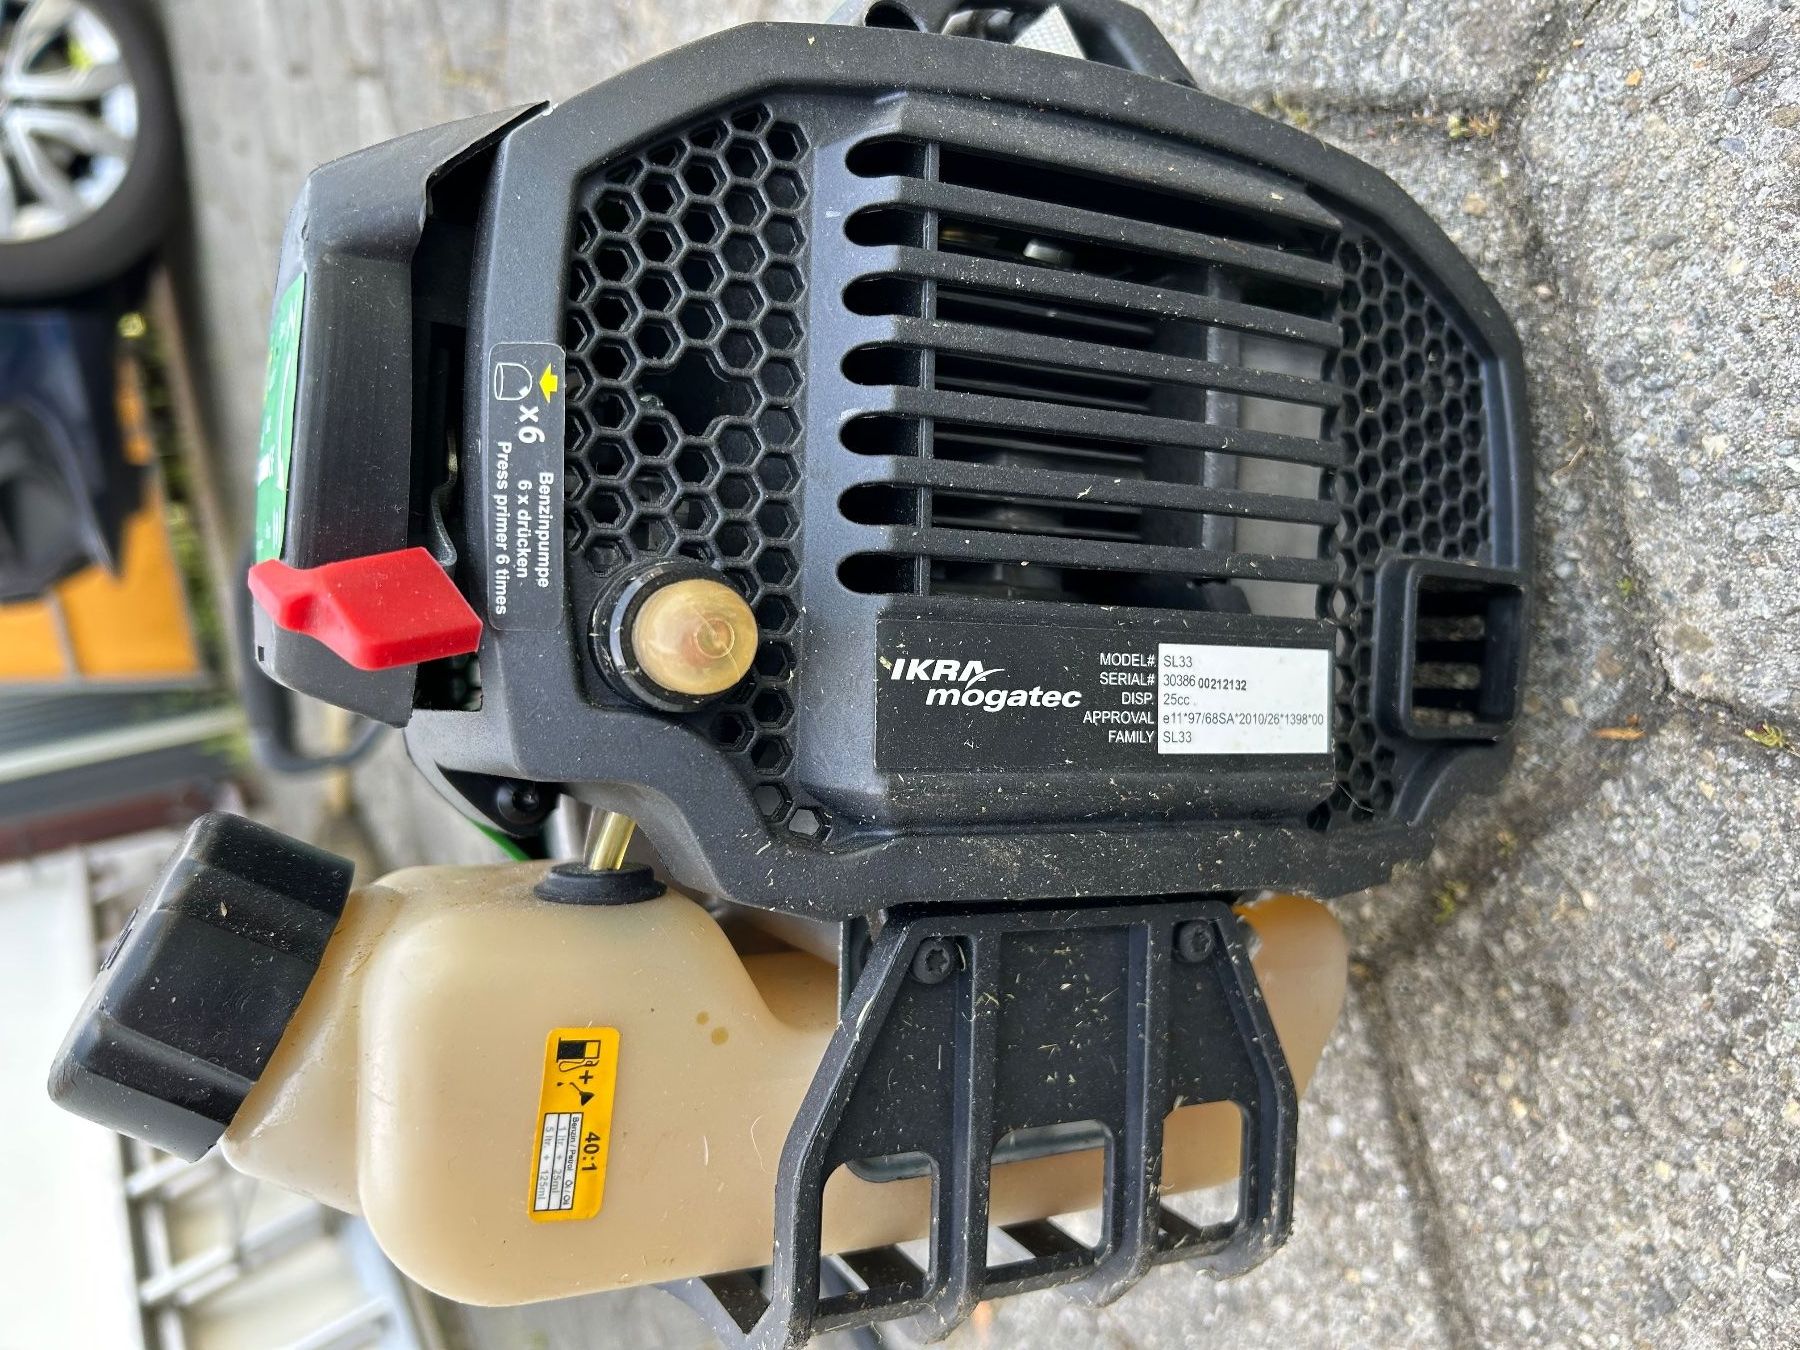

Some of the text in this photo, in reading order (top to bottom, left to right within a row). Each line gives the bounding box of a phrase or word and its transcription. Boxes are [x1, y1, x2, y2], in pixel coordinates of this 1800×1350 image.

[494, 442, 511, 615] Press primer 6 times
[517, 480, 532, 578] 6 x drücken
[534, 472, 554, 588] Benzinpumpe
[891, 659, 995, 685] IKRA
[1100, 653, 1193, 668] MODEL# SL33
[1100, 672, 1247, 690] SERIAL# 30386 00212132
[926, 686, 1081, 712] mogatec
[1121, 691, 1154, 705] DISP.
[1083, 711, 1154, 724] APPROVAL
[1108, 730, 1192, 743] FAMILY SL33
[544, 1135, 553, 1148] ltr.
[557, 1135, 565, 1148] ltr.
[570, 1116, 579, 1143] Benzin
[567, 1149, 576, 1170] Petrol
[582, 1132, 600, 1171] 40:1
[538, 1170, 549, 1200] 125ml
[552, 1169, 561, 1194] 25ml
